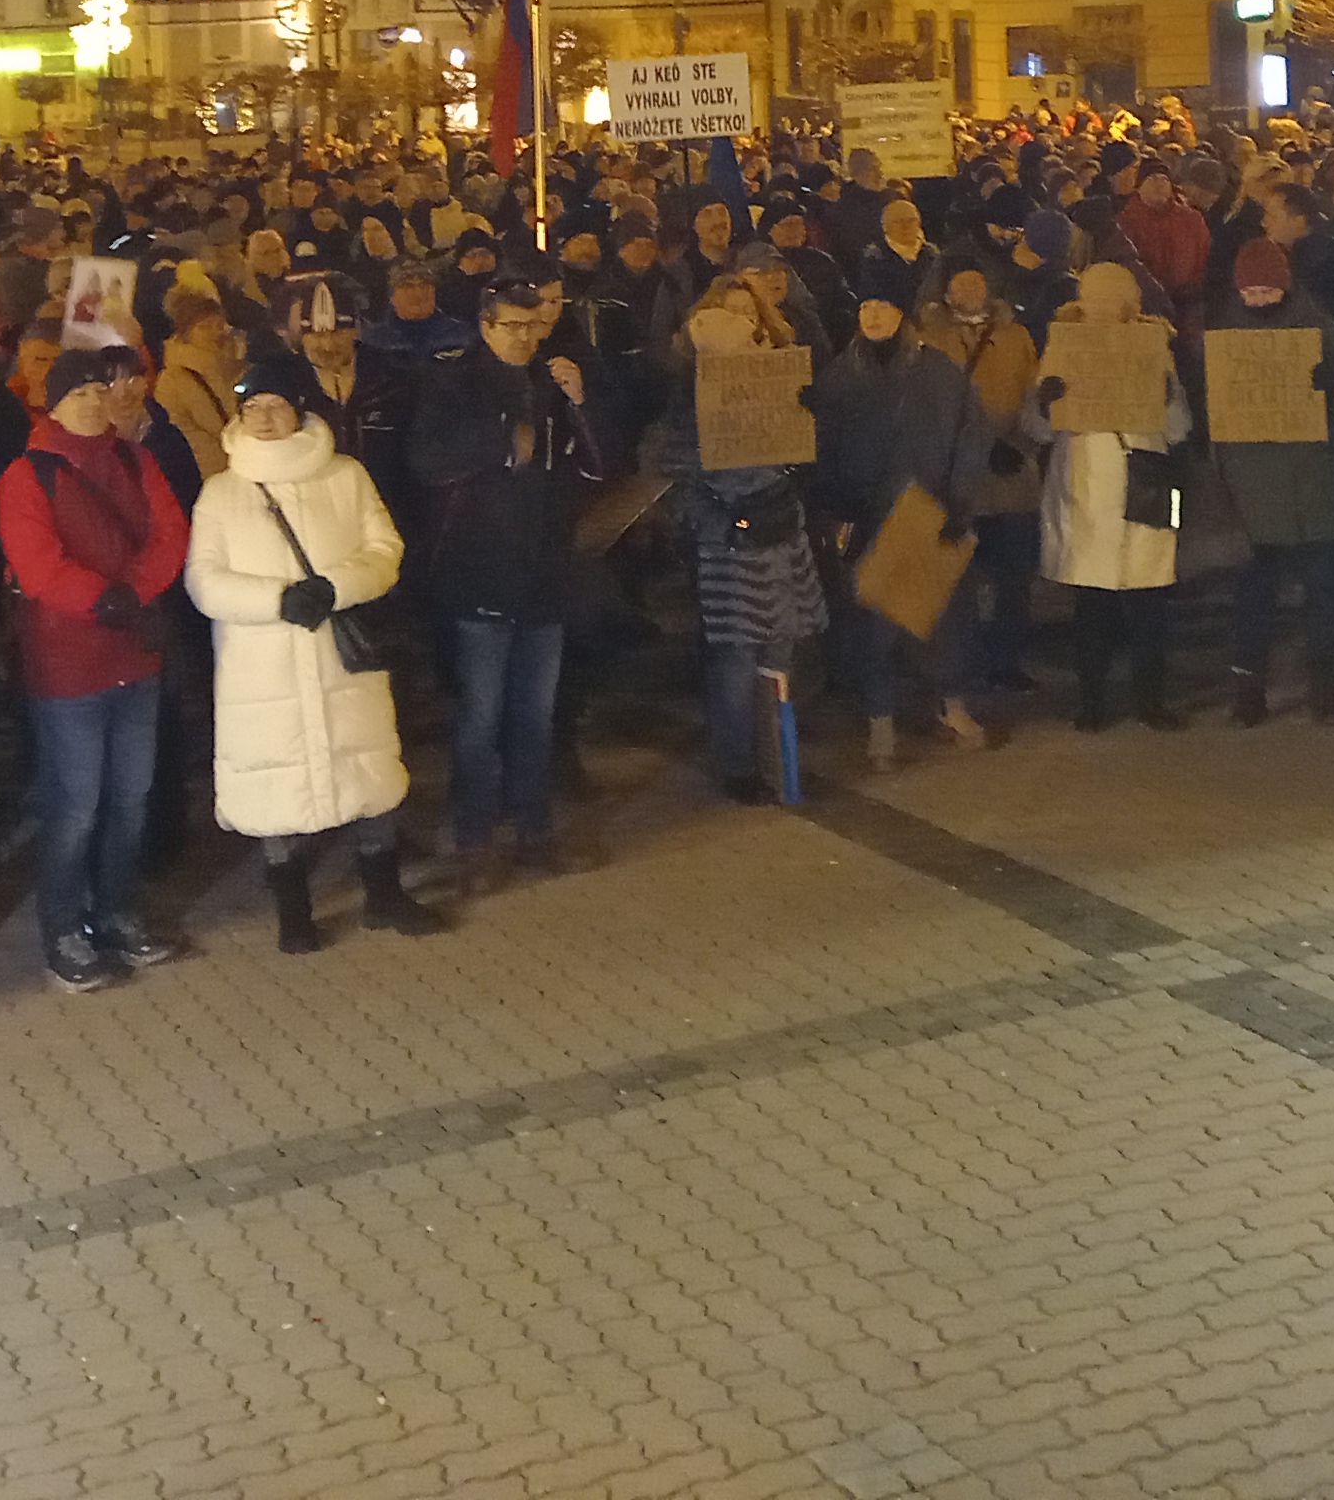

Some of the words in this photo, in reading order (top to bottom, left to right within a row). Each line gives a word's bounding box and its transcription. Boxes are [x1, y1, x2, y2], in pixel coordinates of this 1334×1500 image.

[631, 66, 648, 85] AJ
[654, 62, 681, 83] KEĎ
[692, 62, 716, 81] STE
[625, 90, 681, 111] VYHRALI
[615, 115, 684, 139] NEMÔŽETE
[691, 113, 746, 135] VŠETKO!
